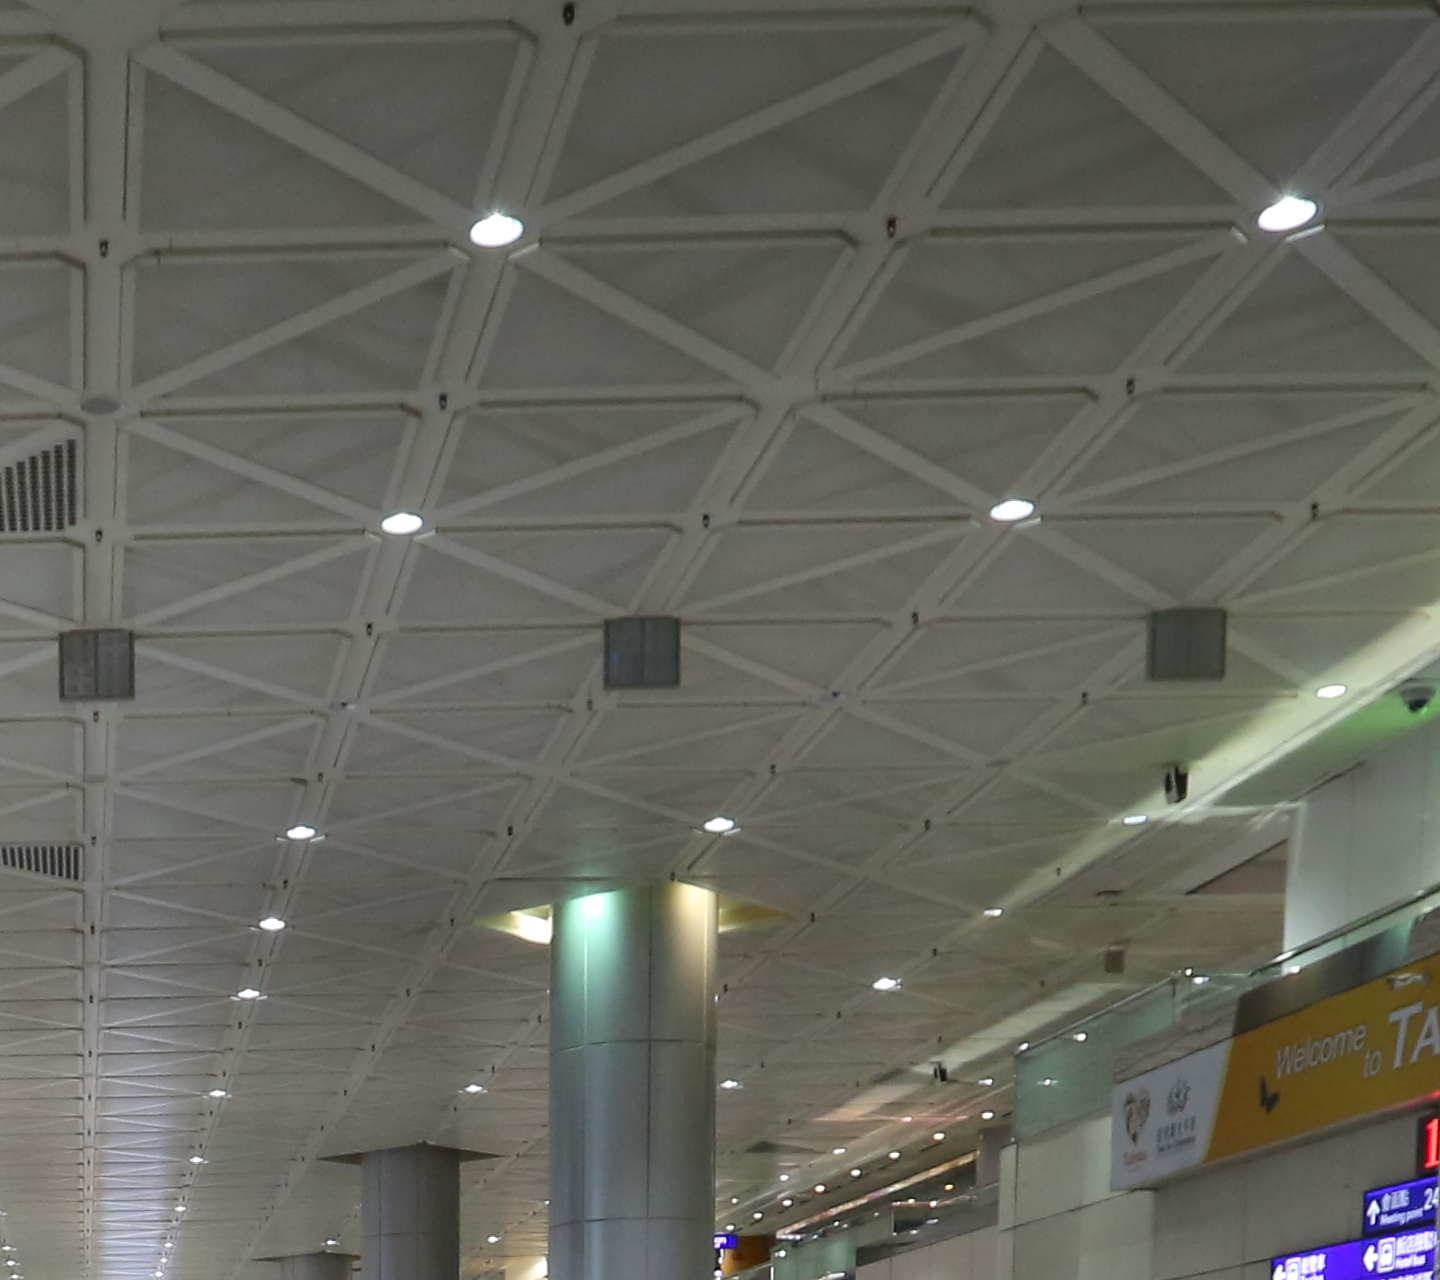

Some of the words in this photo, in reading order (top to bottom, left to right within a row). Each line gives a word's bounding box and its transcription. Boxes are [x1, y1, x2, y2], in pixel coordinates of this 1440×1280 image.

[1276, 1023, 1367, 1079] Welcome
[1363, 1050, 1382, 1078] to
[1413, 1254, 1426, 1266] bus
